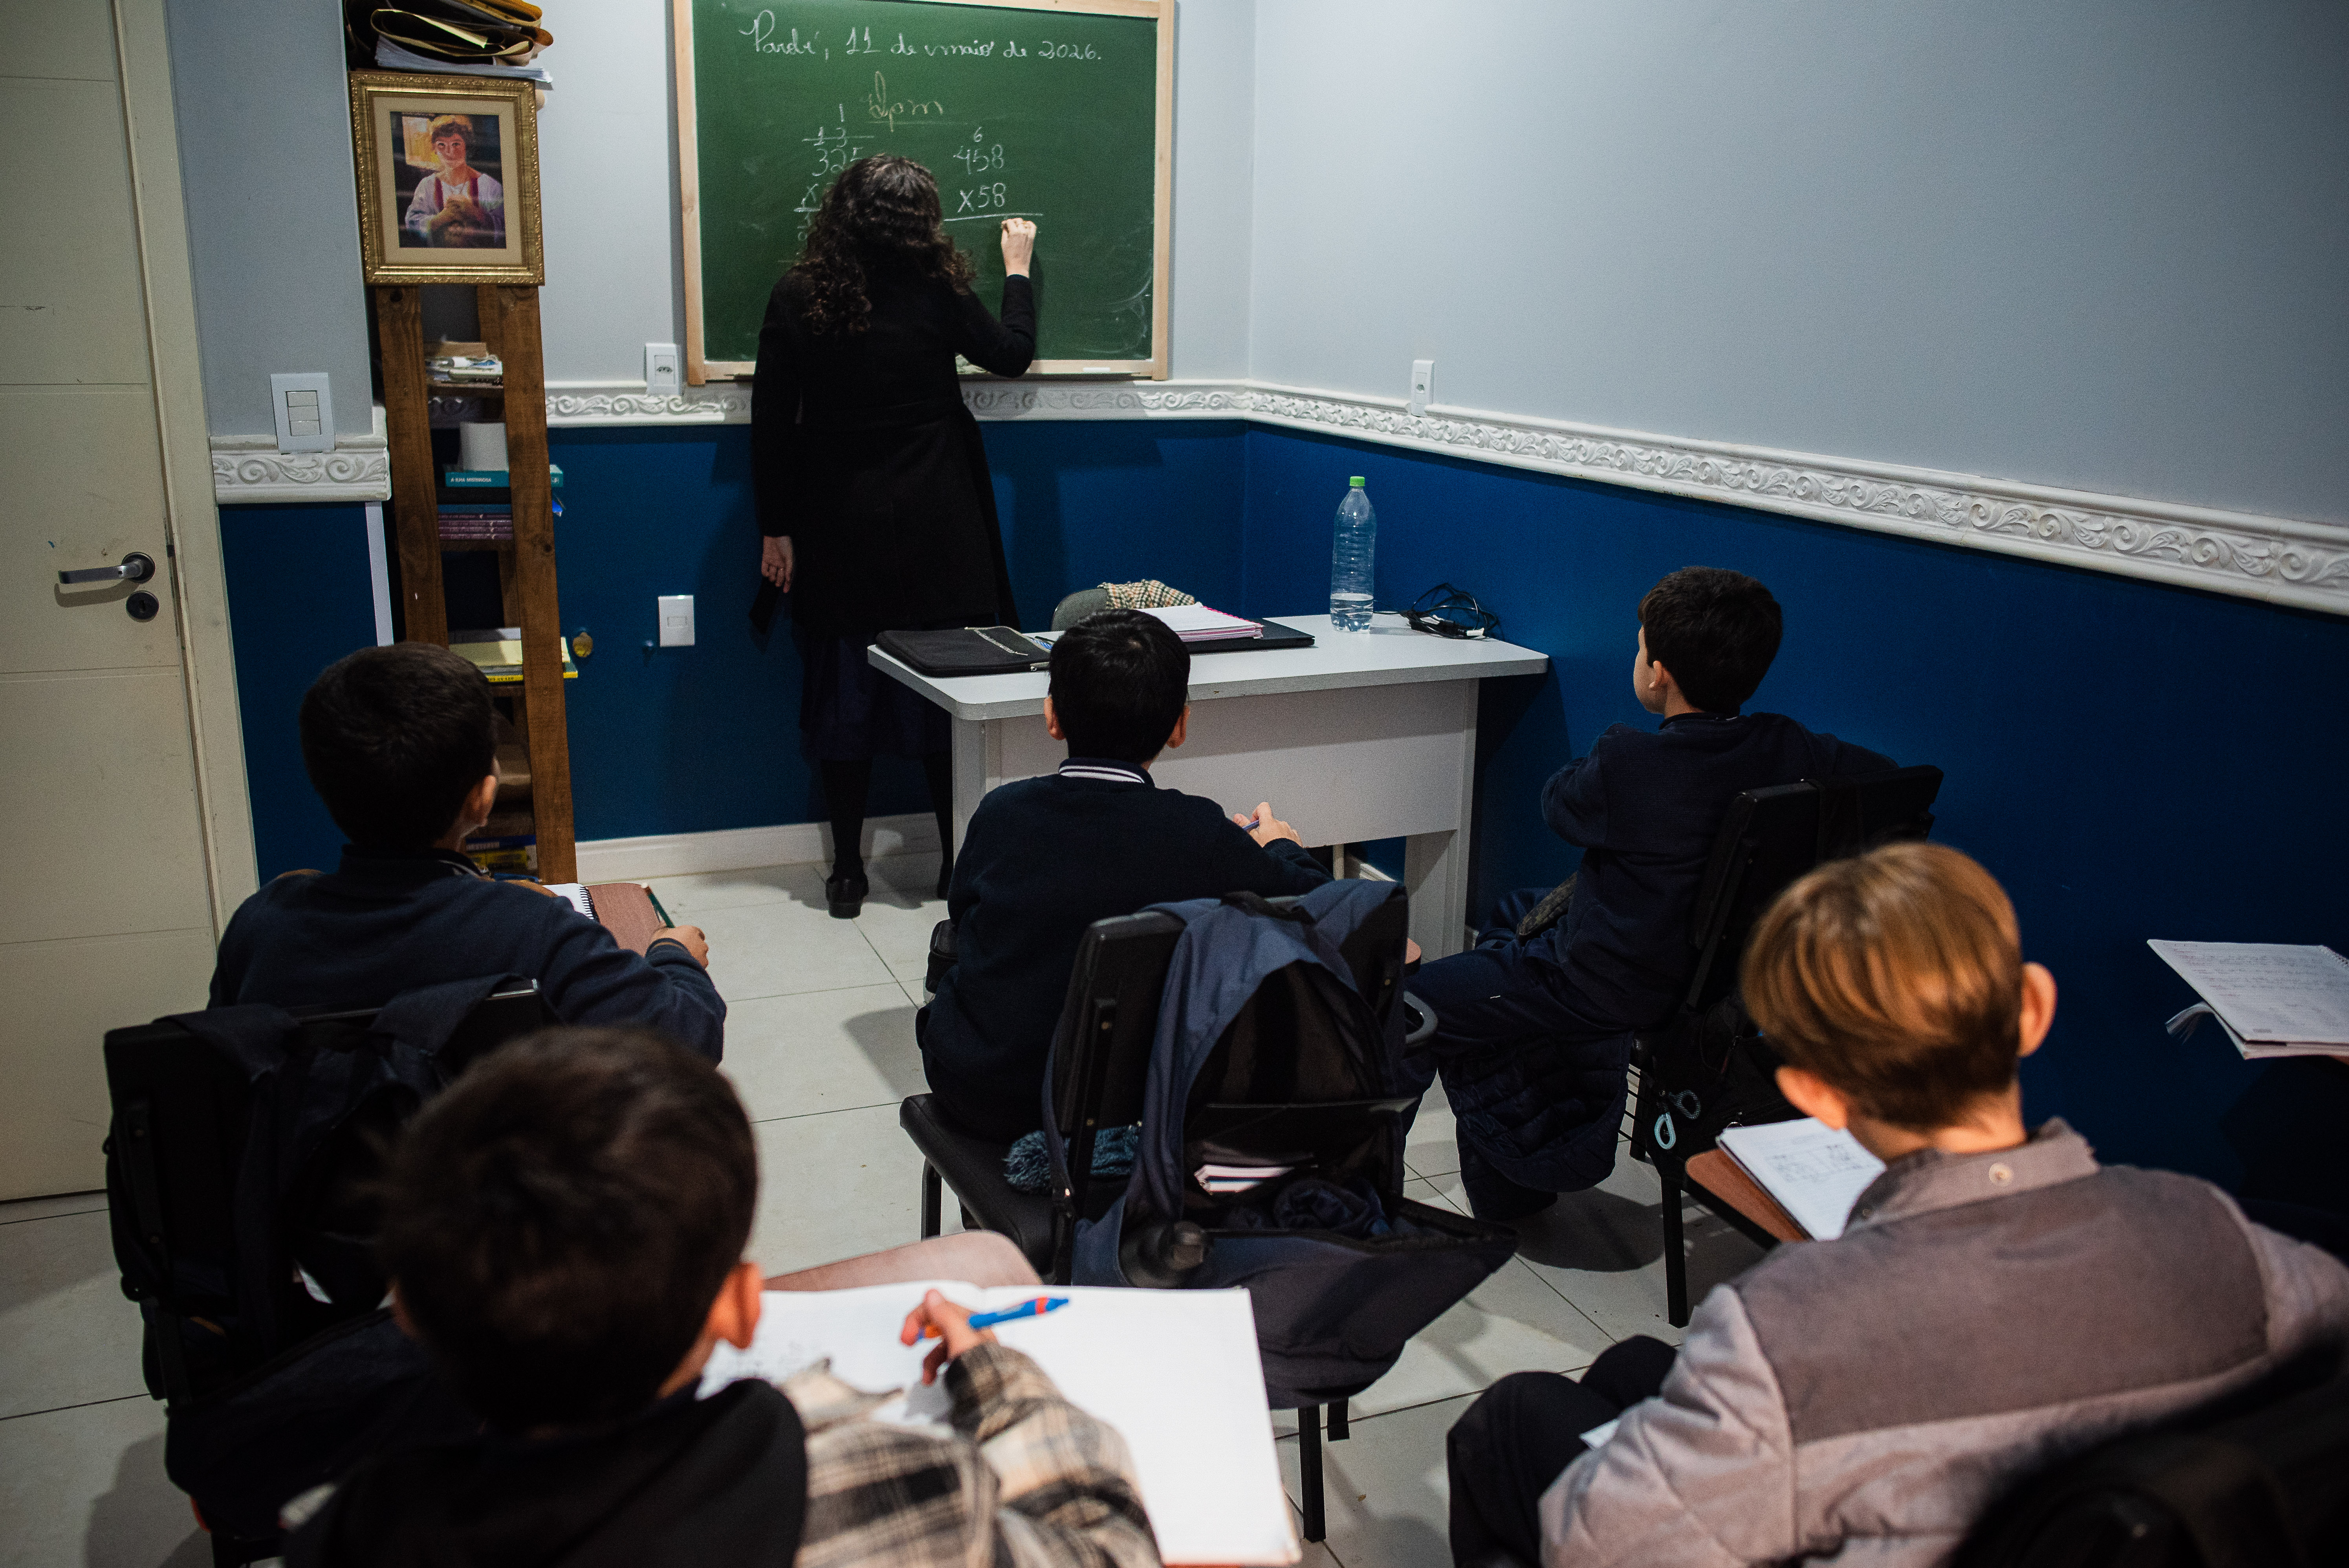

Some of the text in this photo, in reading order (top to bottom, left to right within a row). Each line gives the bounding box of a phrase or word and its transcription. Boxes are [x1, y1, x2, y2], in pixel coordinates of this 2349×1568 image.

[846, 26, 880, 55] 11
[890, 33, 917, 55] de
[1003, 40, 1027, 58] de
[973, 126, 982, 142] 6
[953, 144, 1004, 175] 458
